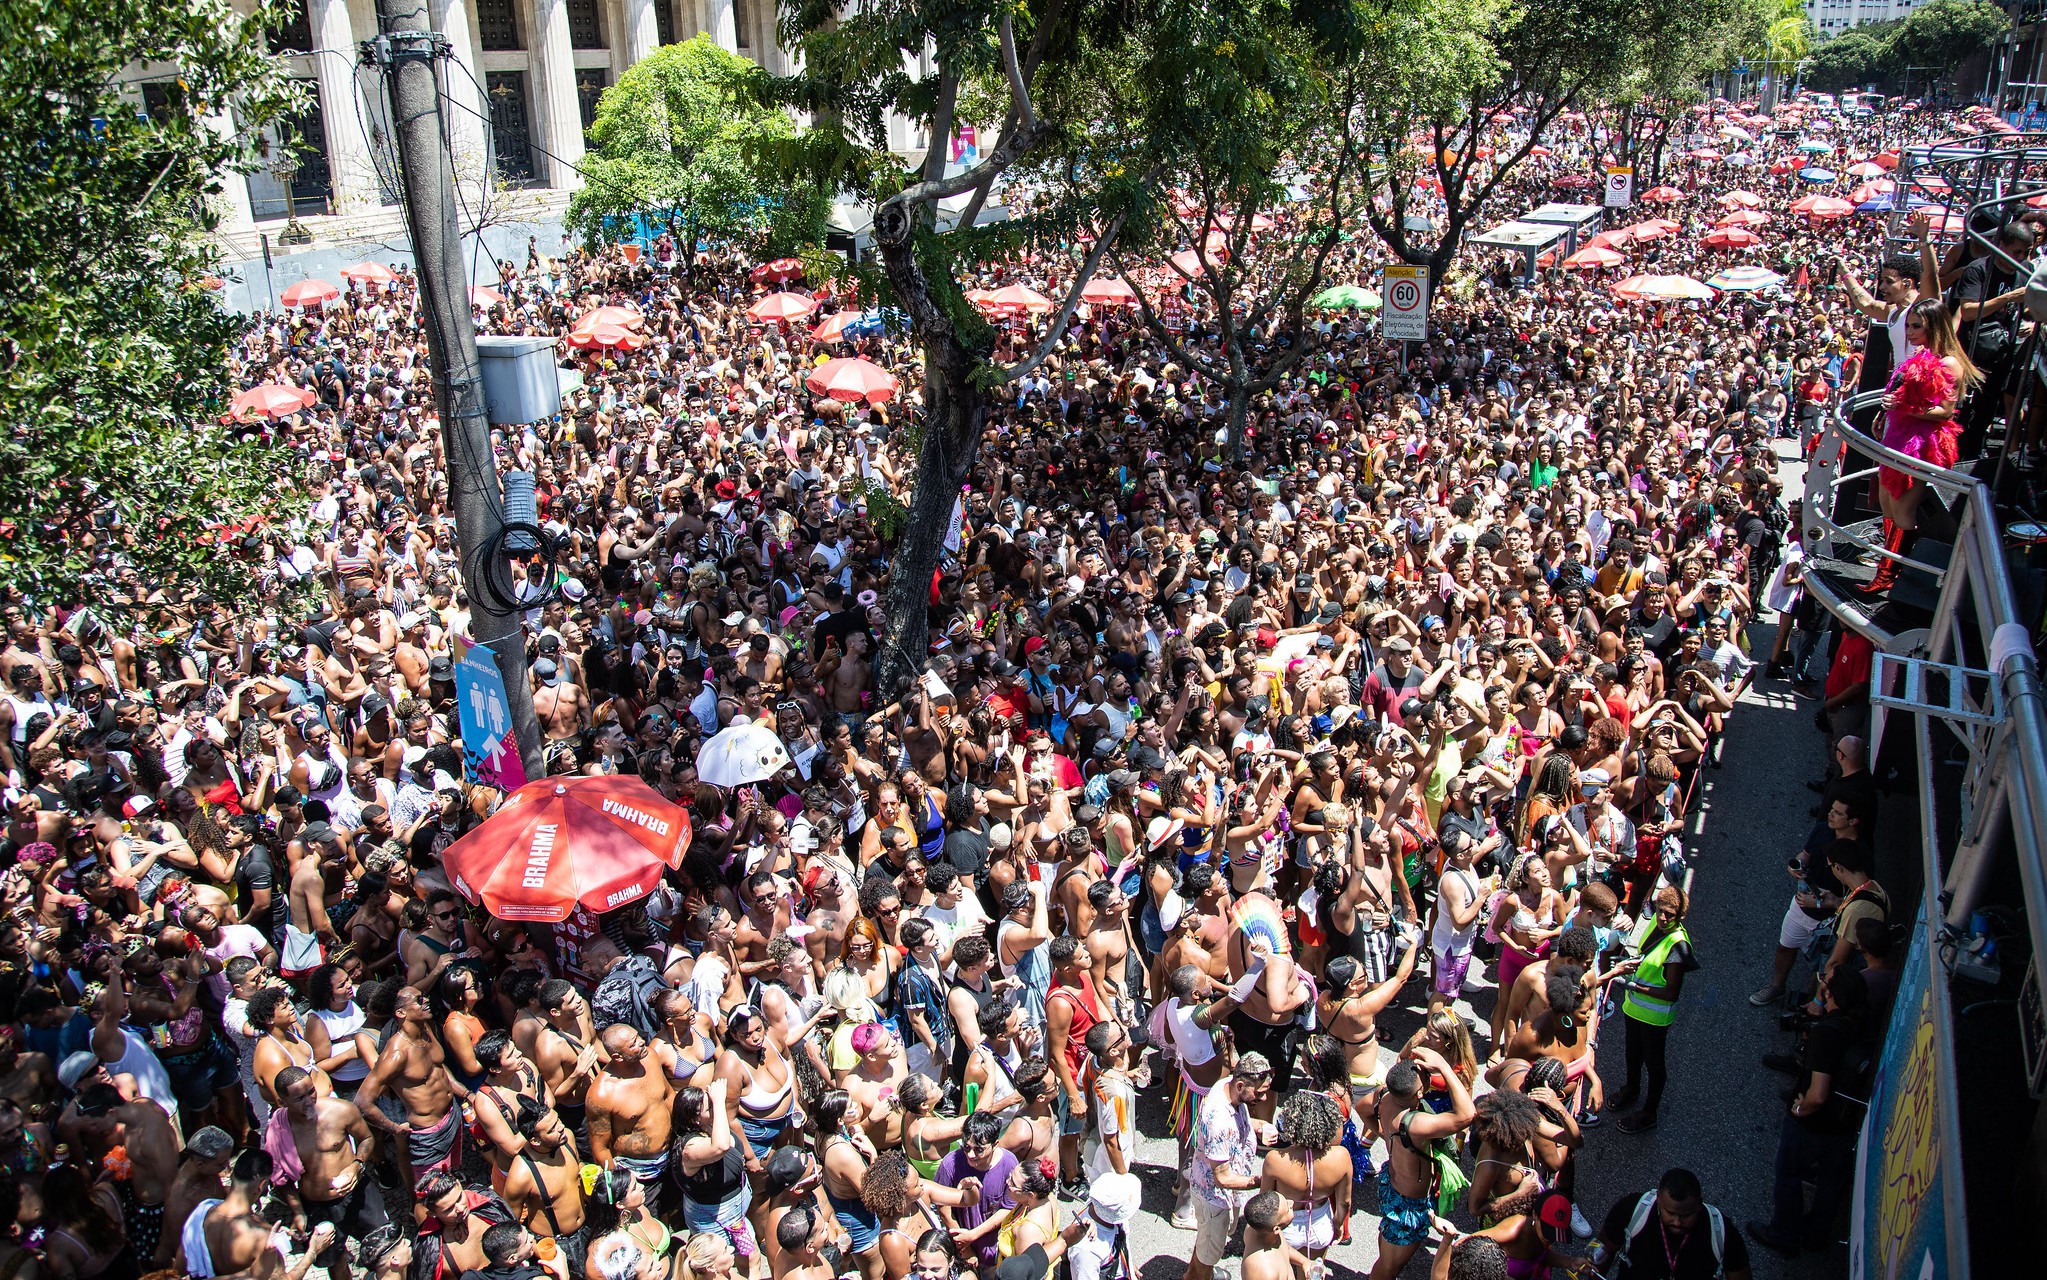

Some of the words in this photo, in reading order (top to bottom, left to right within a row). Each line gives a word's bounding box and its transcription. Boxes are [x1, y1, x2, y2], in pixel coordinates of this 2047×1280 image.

[1388, 269, 1412, 277] Atenção
[1396, 286, 1414, 301] 60
[1386, 312, 1423, 320] Fiscalização
[1388, 329, 1420, 337] Velocidade
[460, 655, 499, 679] BANHEIROS
[602, 798, 670, 836] BRAHMA
[521, 823, 559, 888] BRAHMA
[606, 883, 643, 908] BRAHMA
